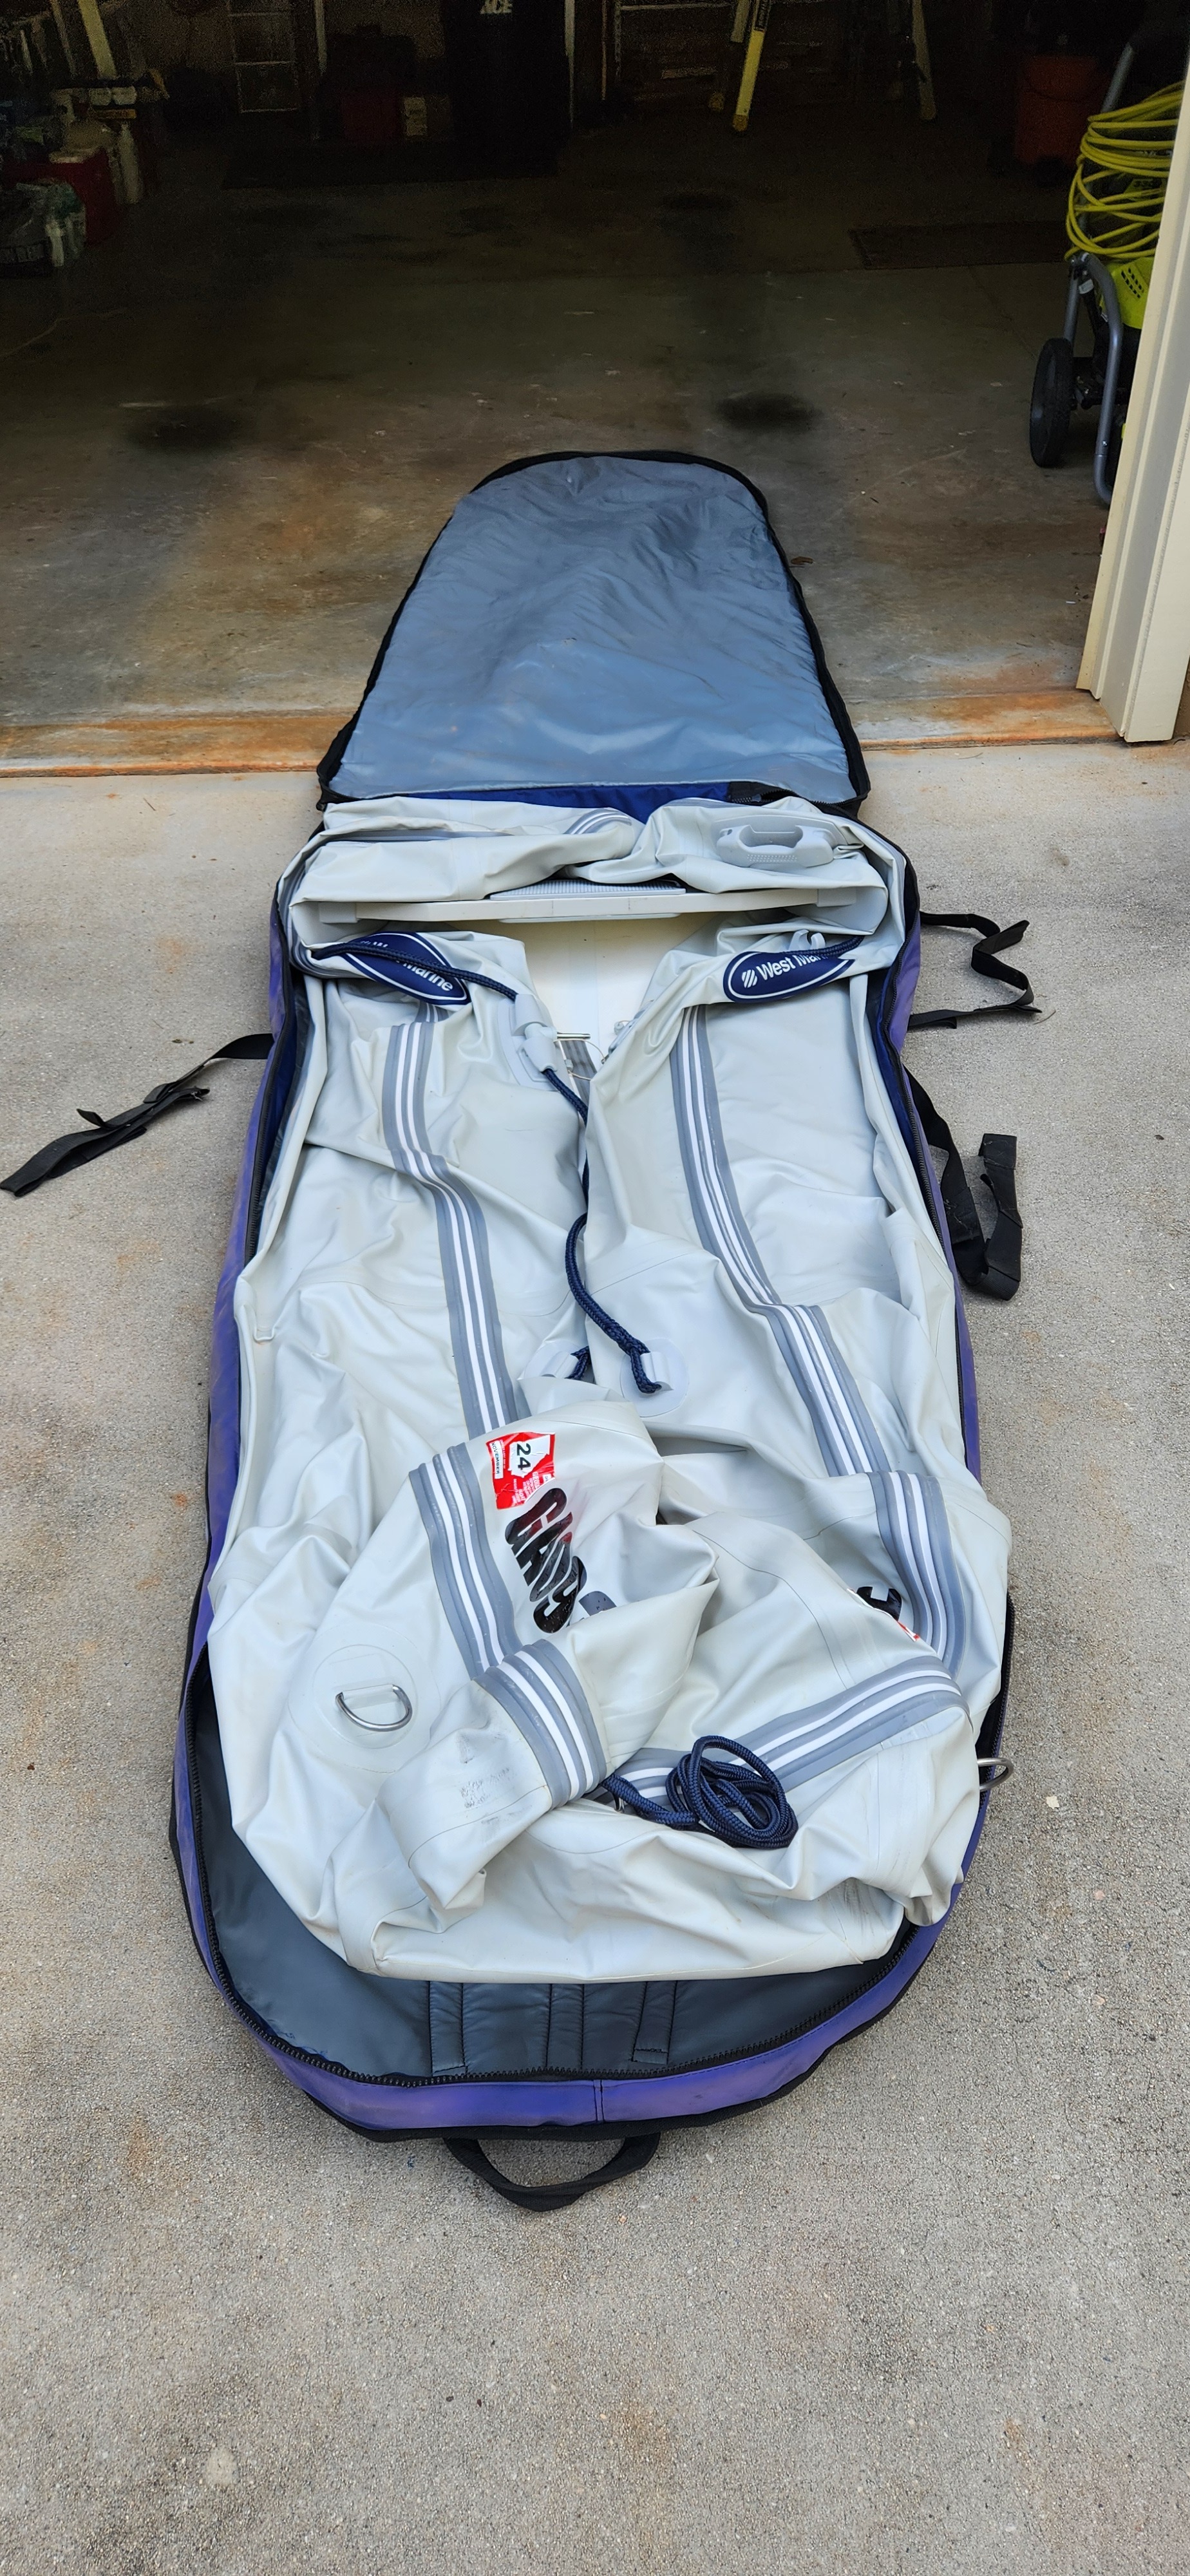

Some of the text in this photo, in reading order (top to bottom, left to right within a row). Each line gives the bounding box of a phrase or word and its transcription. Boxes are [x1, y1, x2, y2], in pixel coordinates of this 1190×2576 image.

[756, 956, 797, 981] West
[491, 1443, 500, 1474] NOVEMBER
[517, 1443, 531, 1470] 24
